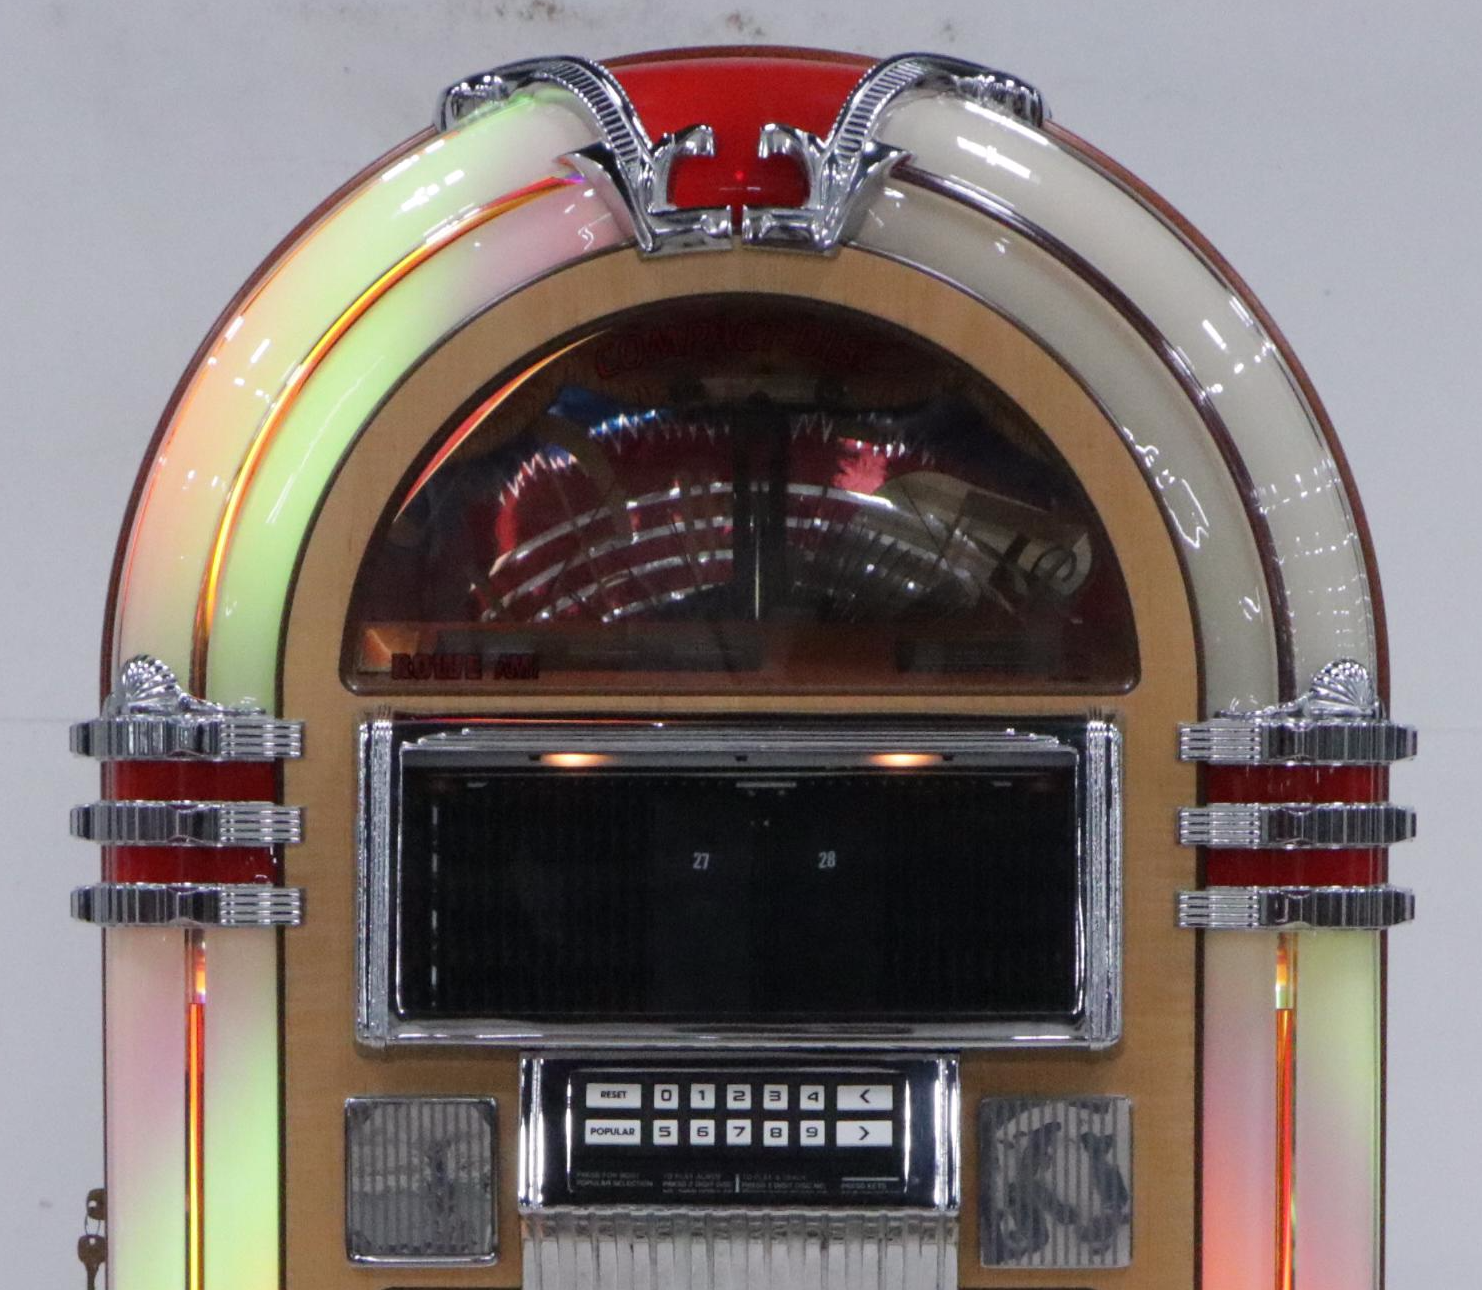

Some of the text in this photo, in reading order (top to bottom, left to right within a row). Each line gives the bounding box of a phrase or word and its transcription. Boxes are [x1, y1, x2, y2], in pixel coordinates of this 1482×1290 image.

[692, 850, 837, 870] 27 28
[600, 1090, 628, 1099] RESET
[698, 1090, 705, 1101] 1
[732, 1090, 746, 1102] 2
[769, 1090, 782, 1102] 3
[807, 1091, 819, 1103] 4
[590, 1126, 819, 1138] POPULAR 5 6 7 8 9
[576, 1179, 654, 1187] POPULAR SELECTION
